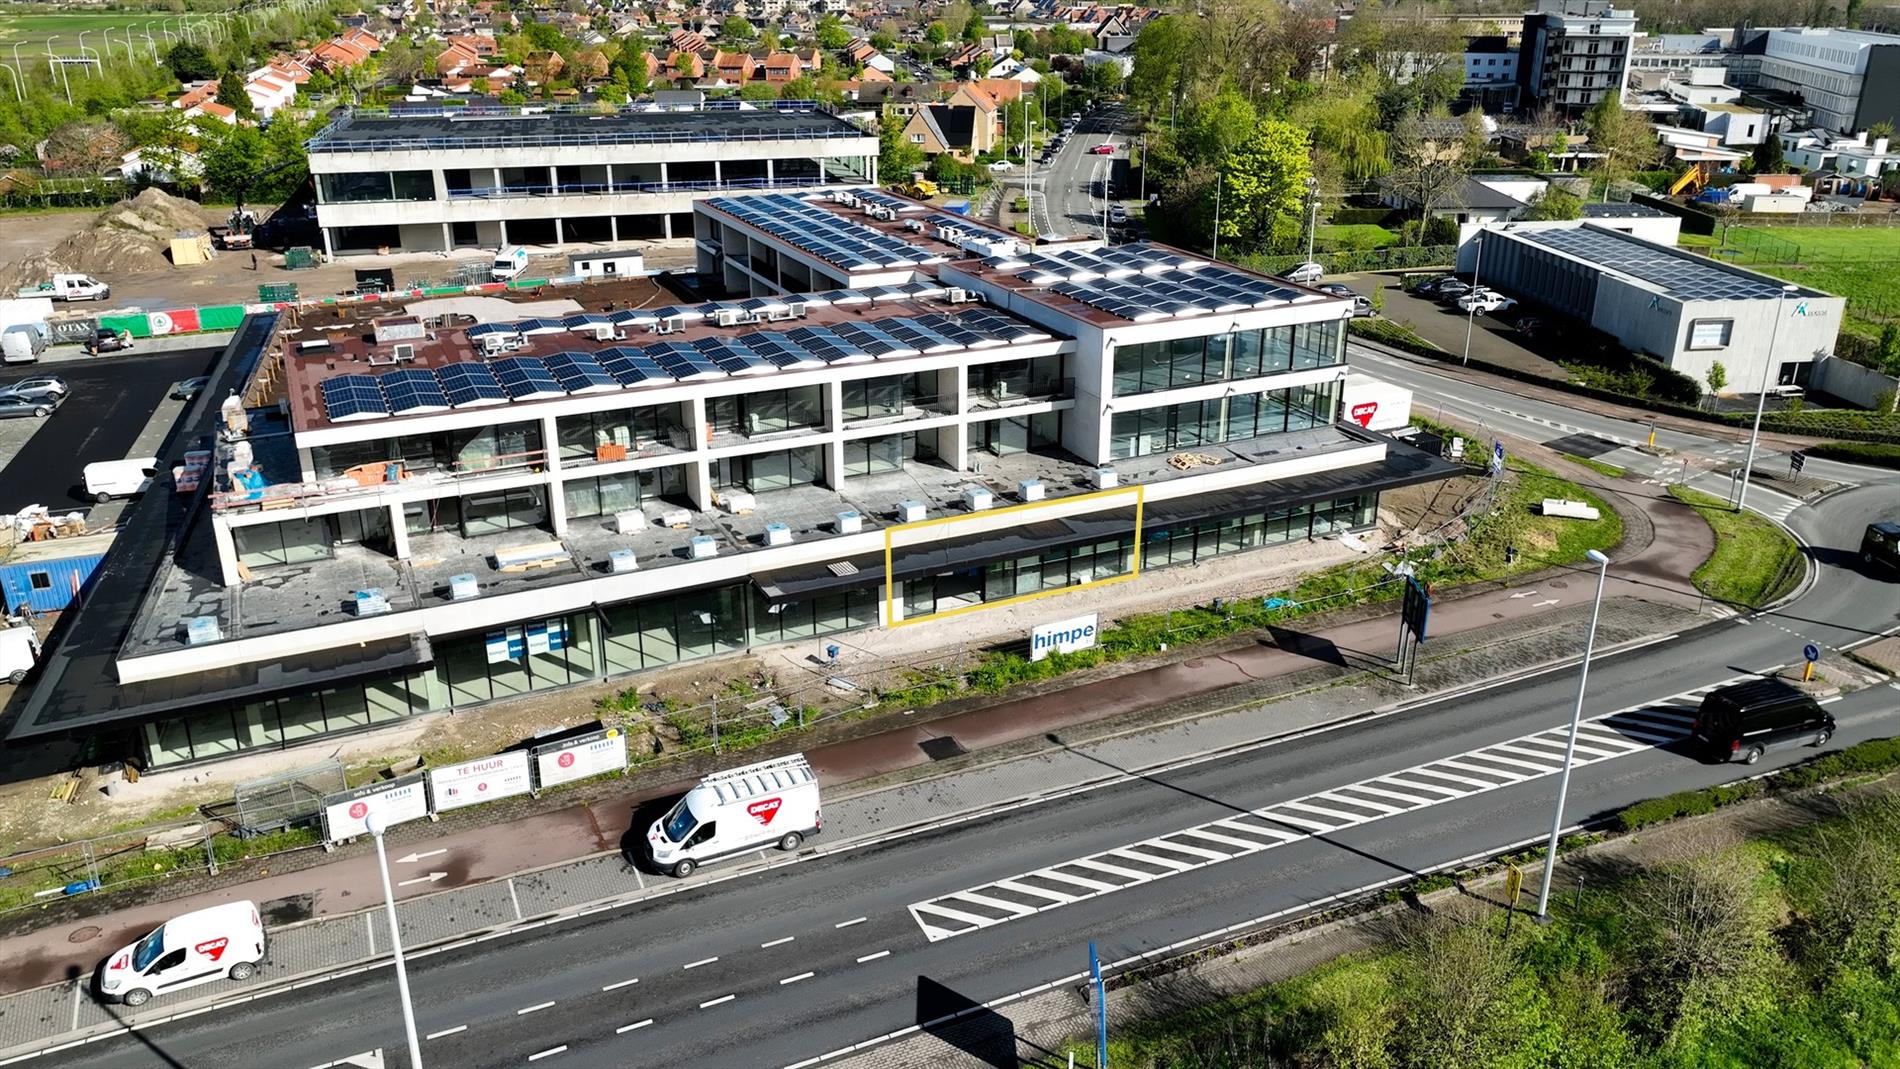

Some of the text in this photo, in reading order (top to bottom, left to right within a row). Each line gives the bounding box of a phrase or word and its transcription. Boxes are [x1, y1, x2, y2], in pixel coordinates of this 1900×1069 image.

[1034, 625, 1094, 649] himpe
[456, 767, 469, 776] TE
[473, 759, 504, 773] HUUR
